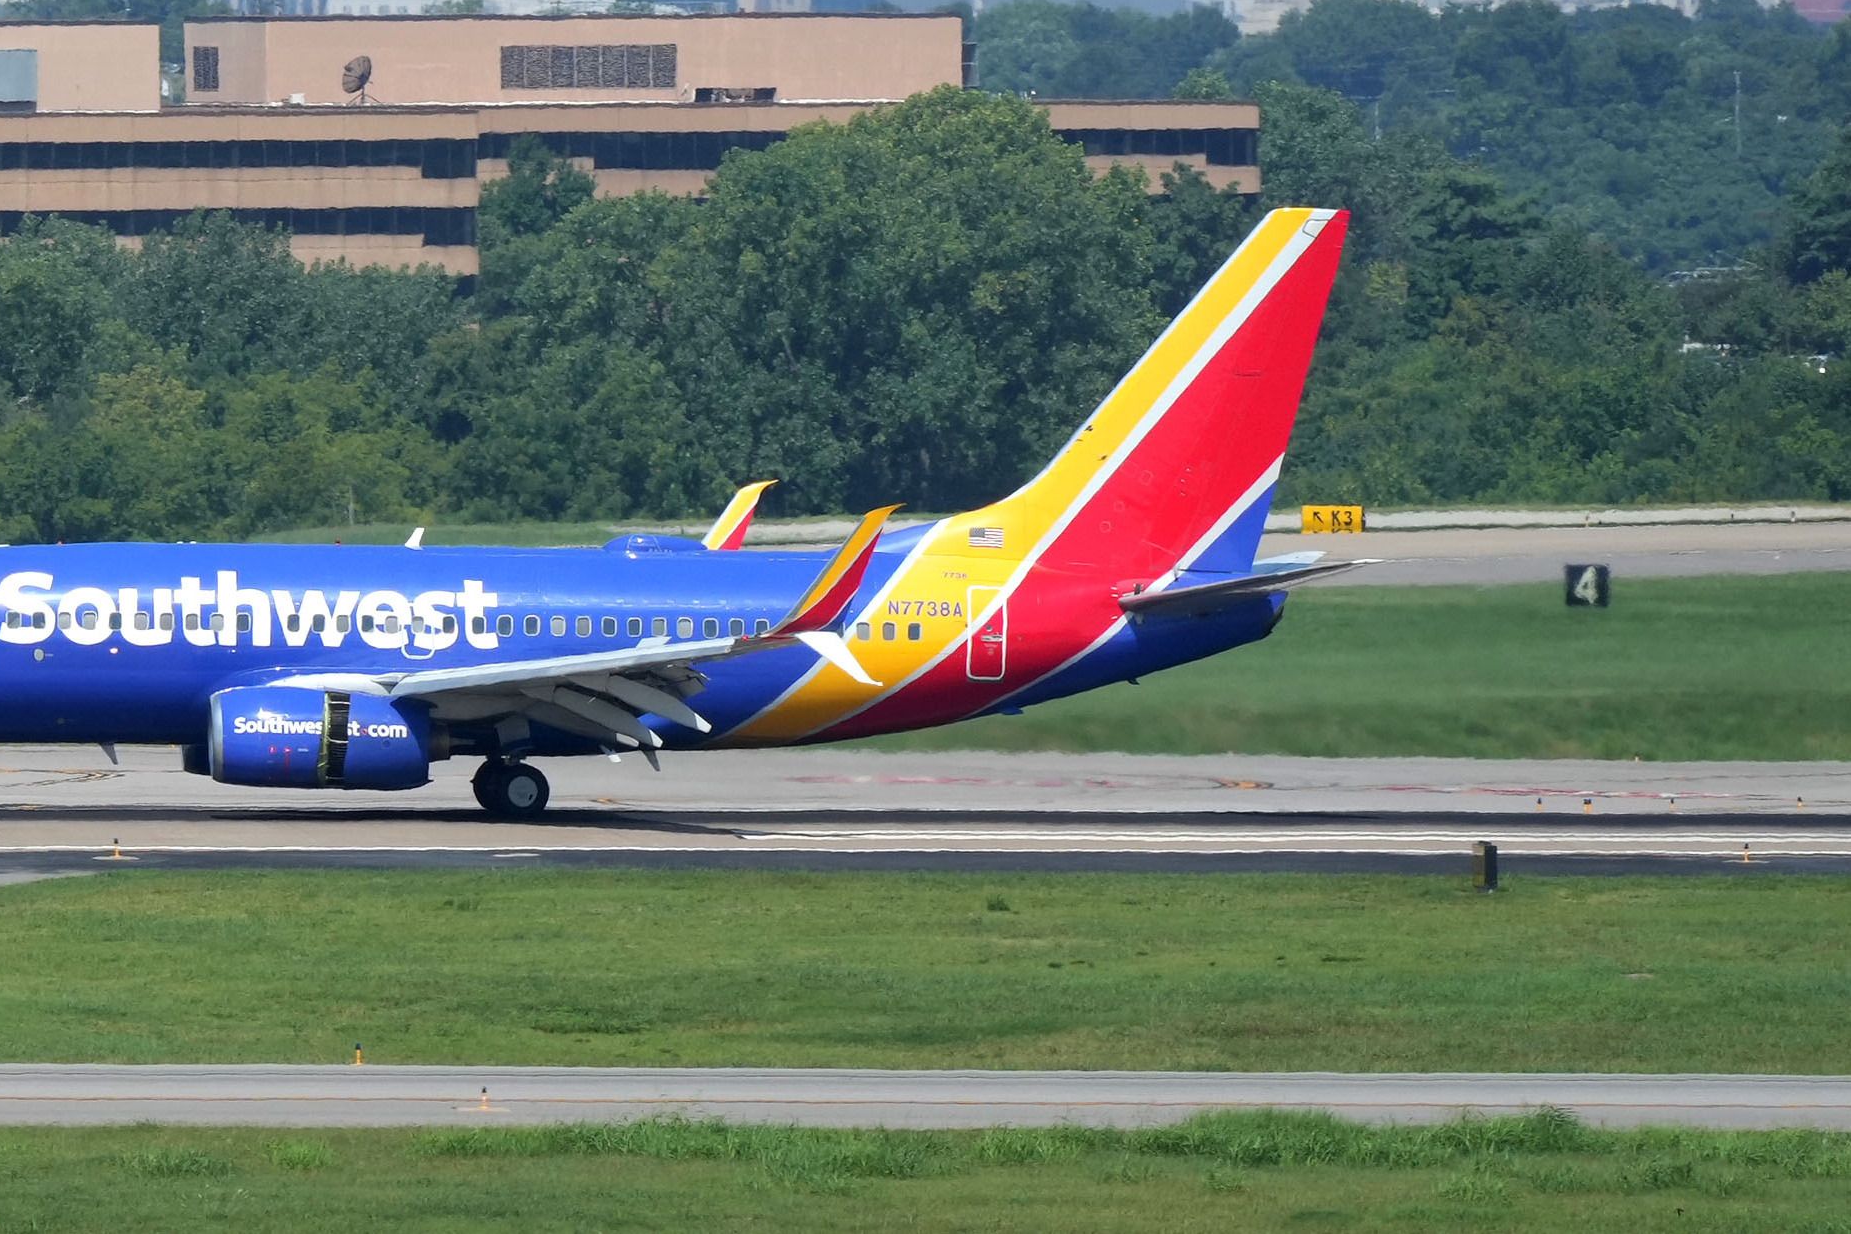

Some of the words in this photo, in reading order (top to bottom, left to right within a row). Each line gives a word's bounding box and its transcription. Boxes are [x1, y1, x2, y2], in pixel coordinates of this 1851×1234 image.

[1331, 510, 1353, 526] K3
[1574, 565, 1598, 604] 4
[888, 601, 962, 616] N7738A
